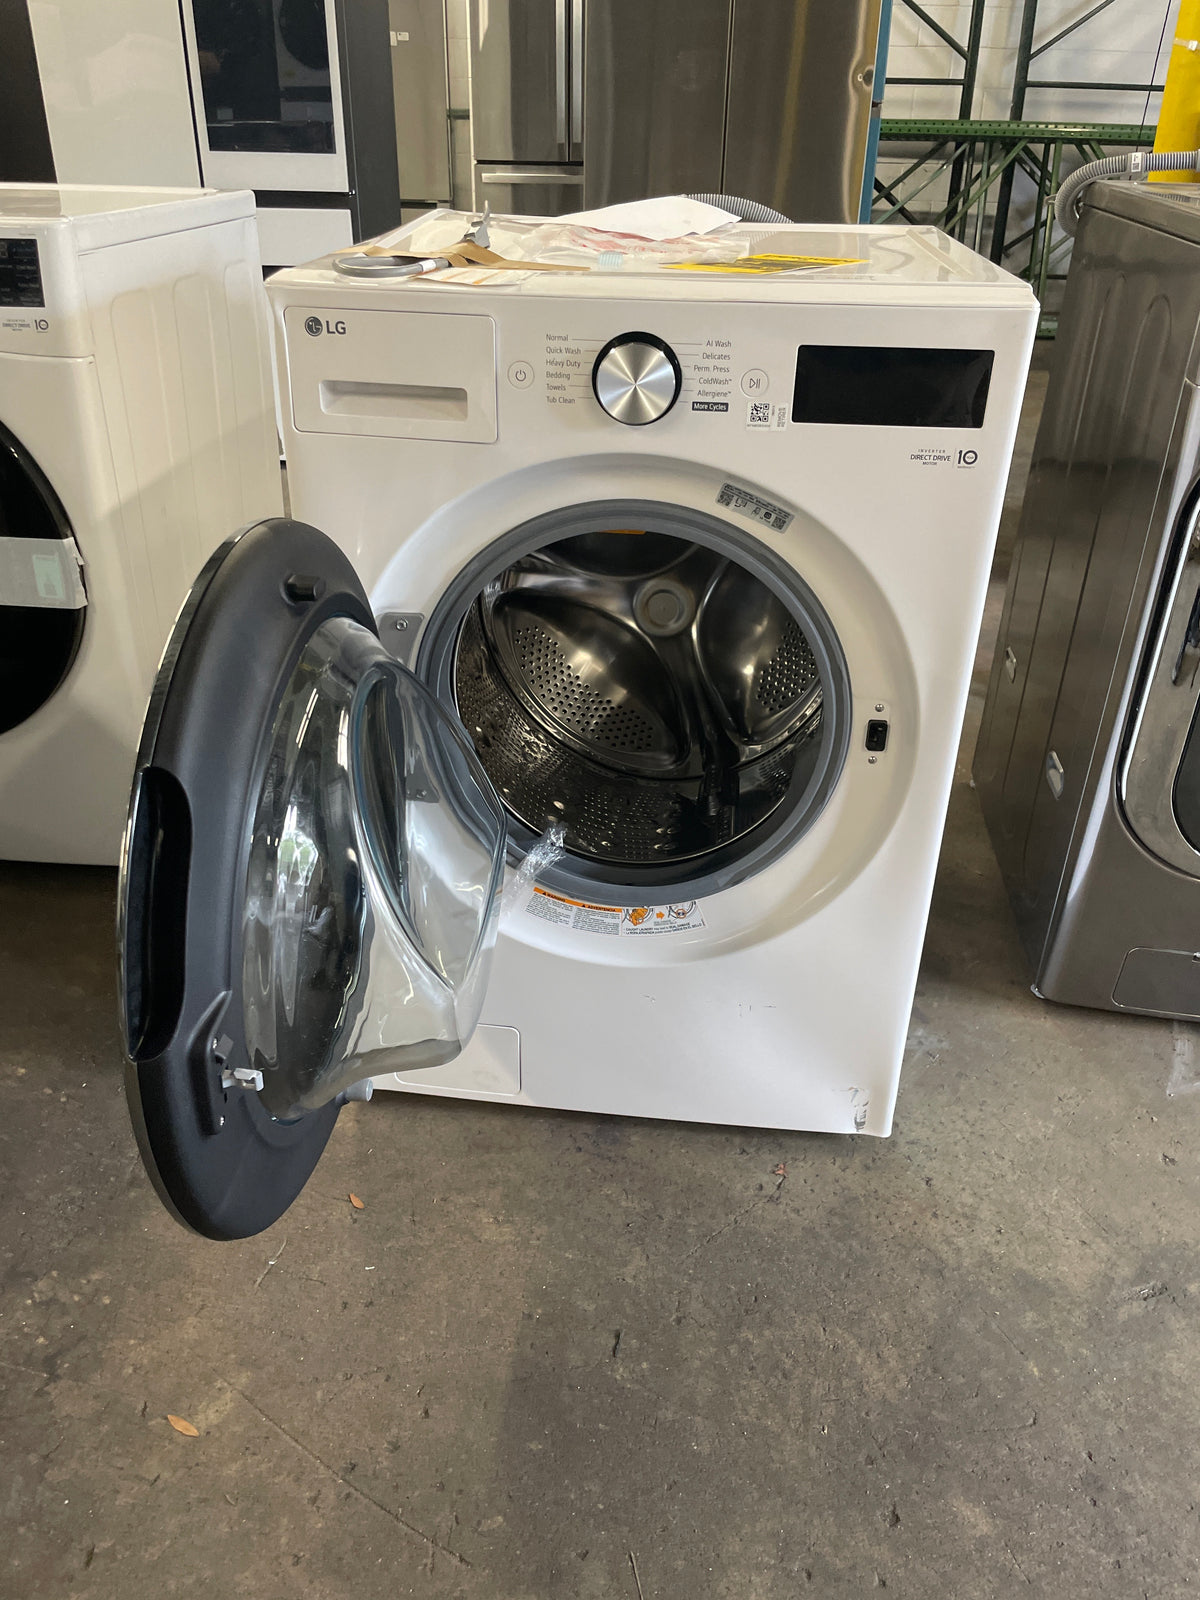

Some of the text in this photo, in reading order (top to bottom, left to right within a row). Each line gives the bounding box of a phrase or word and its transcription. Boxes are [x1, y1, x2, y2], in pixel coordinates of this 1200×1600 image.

[325, 320, 347, 335] LG
[546, 359, 581, 368] Heavy Duty
[546, 371, 571, 380] Bedding
[709, 403, 727, 411] Cycles
[957, 450, 978, 465] 10
